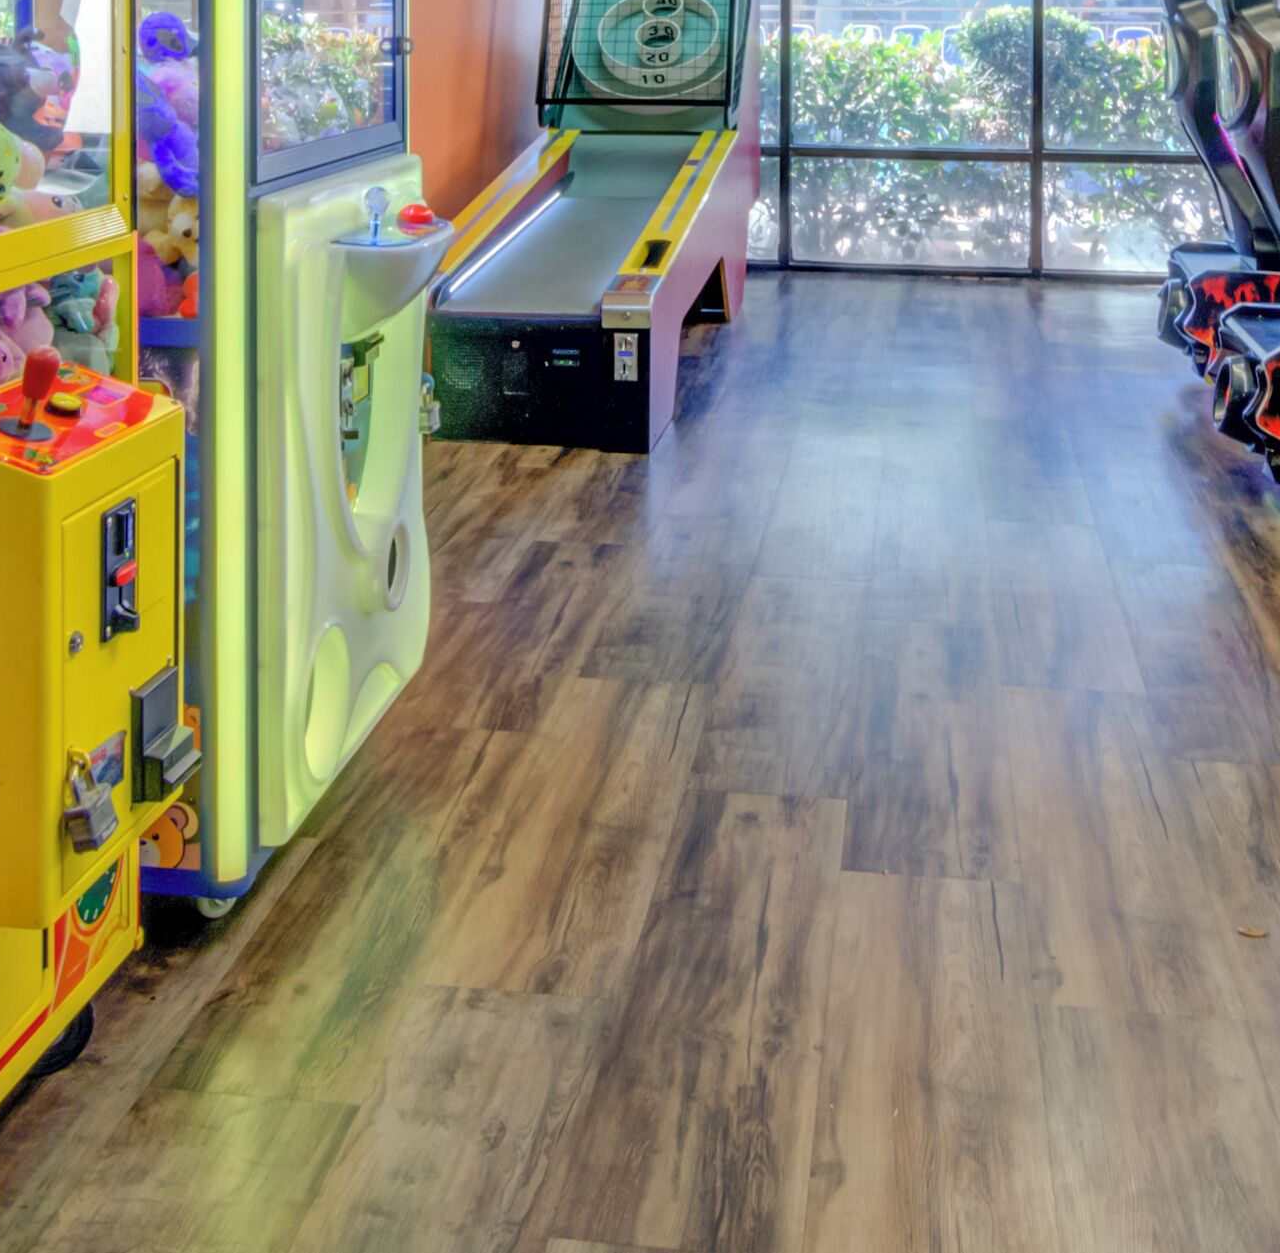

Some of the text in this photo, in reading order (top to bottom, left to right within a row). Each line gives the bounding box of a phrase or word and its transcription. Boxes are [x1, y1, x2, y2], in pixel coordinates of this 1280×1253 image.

[649, 26, 674, 37] 30
[646, 52, 669, 63] 20
[642, 74, 665, 84] 10
